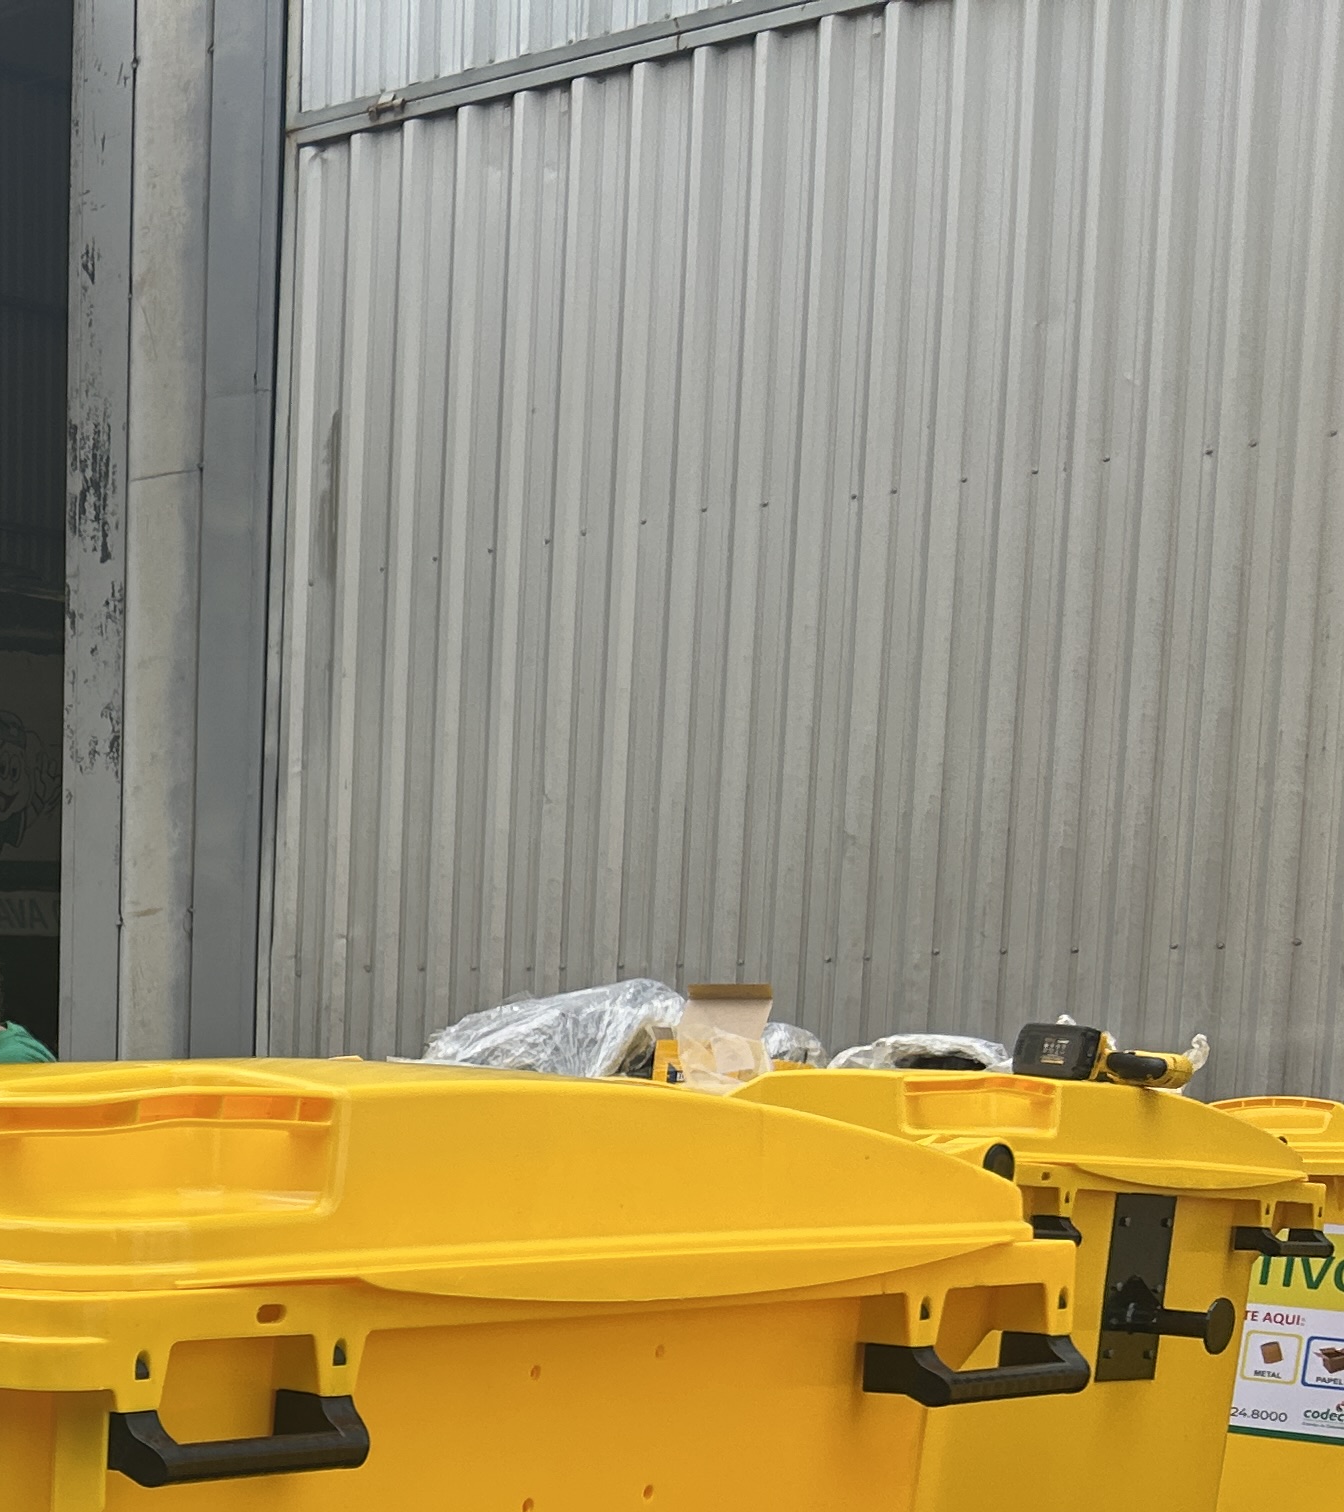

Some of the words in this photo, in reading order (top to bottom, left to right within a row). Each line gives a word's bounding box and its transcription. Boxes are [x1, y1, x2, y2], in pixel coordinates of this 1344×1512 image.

[1263, 1312, 1306, 1327] AQUI:
[1254, 1369, 1282, 1379] METAL
[1316, 1376, 1344, 1386] PAPEL
[1230, 1406, 1288, 1422] 24.8000
[1303, 1407, 1344, 1422] codec
